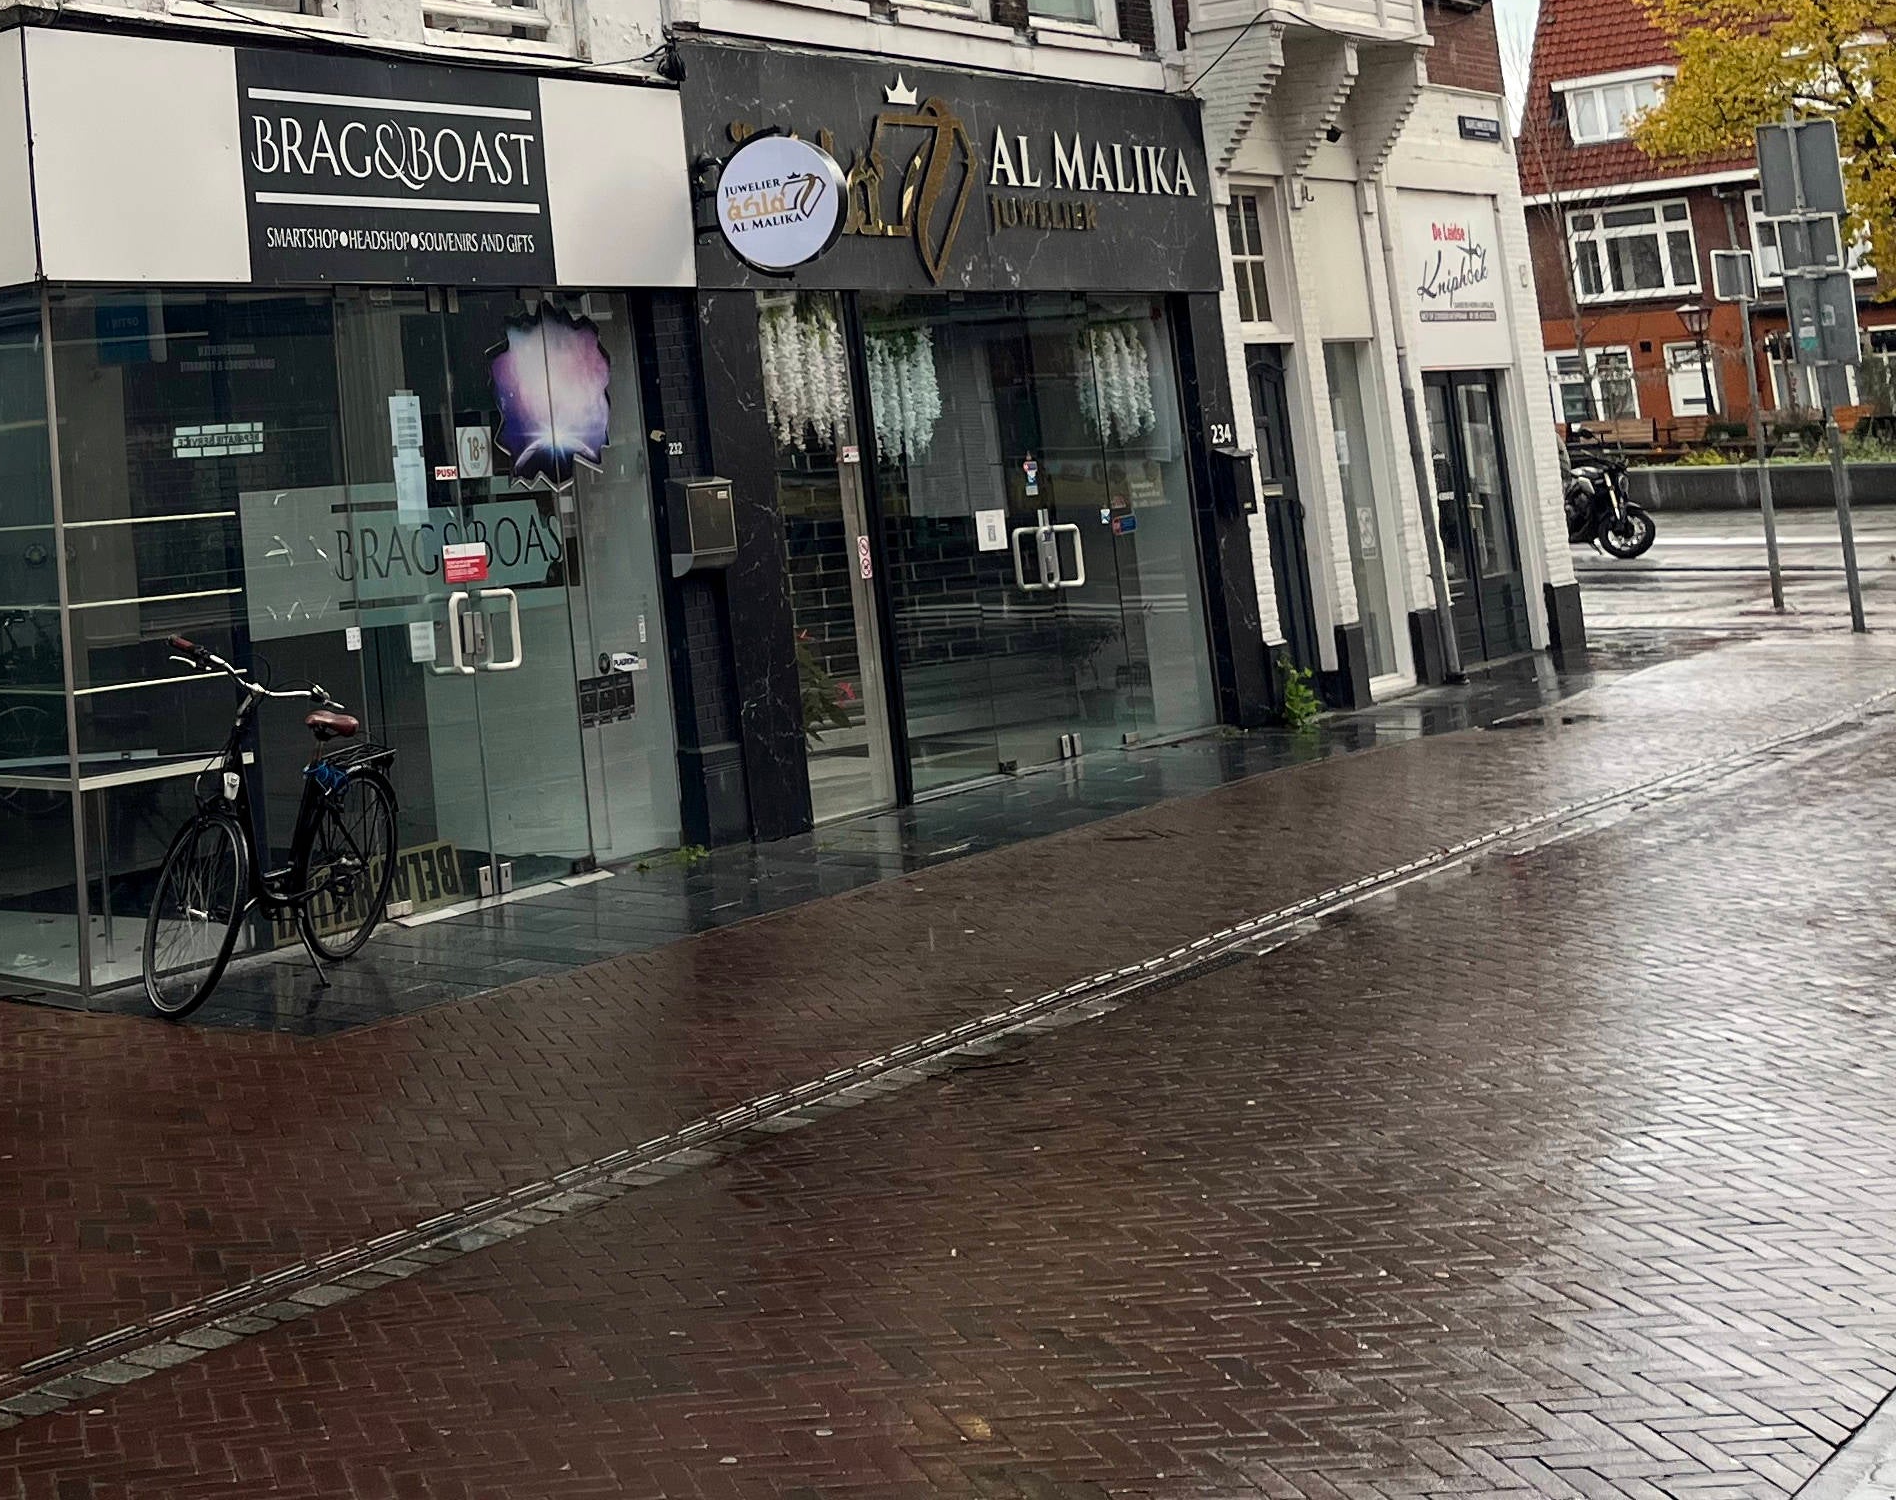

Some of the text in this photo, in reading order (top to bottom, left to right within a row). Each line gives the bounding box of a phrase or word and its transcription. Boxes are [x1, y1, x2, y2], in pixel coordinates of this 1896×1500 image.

[251, 116, 534, 190] BRAG&BOAST
[990, 124, 1198, 197] AL MALIKA
[724, 178, 781, 198] JUWELIER
[731, 212, 803, 234] AL MALIKA
[991, 194, 1098, 237] JUWELIER
[267, 227, 535, 254] SMARTSHOP HEADSHOP SOUVENIRS AND GIFTS
[1417, 249, 1488, 308] Kniphoek
[1210, 423, 1232, 444] 234
[467, 435, 486, 462] 18+
[668, 441, 684, 456] 232
[436, 467, 457, 479] PUSH
